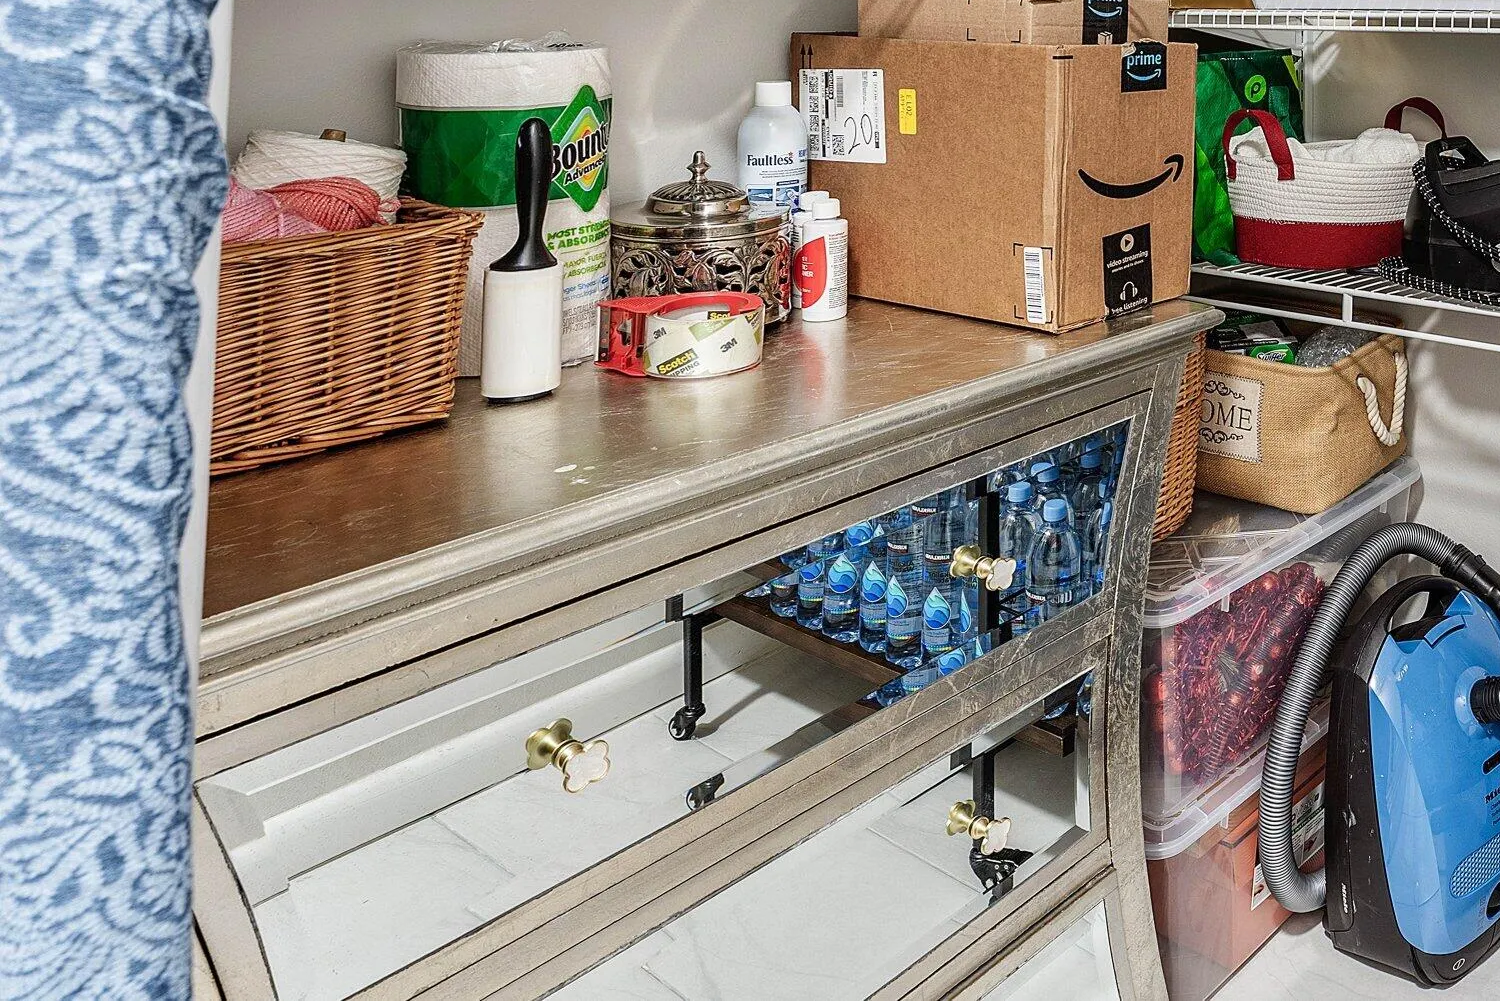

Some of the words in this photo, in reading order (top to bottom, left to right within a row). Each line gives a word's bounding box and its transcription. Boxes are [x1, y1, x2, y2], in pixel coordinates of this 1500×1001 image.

[1127, 51, 1162, 69] prime
[844, 114, 872, 154] 20
[747, 155, 793, 166] Faultless
[547, 227, 577, 241] MOST
[1106, 258, 1122, 269] video
[1122, 251, 1148, 264] streaming
[1123, 297, 1148, 310] listening
[653, 327, 667, 340] 3M
[720, 337, 738, 353] 3M
[658, 350, 697, 375] Scotch
[1200, 398, 1253, 432] OME
